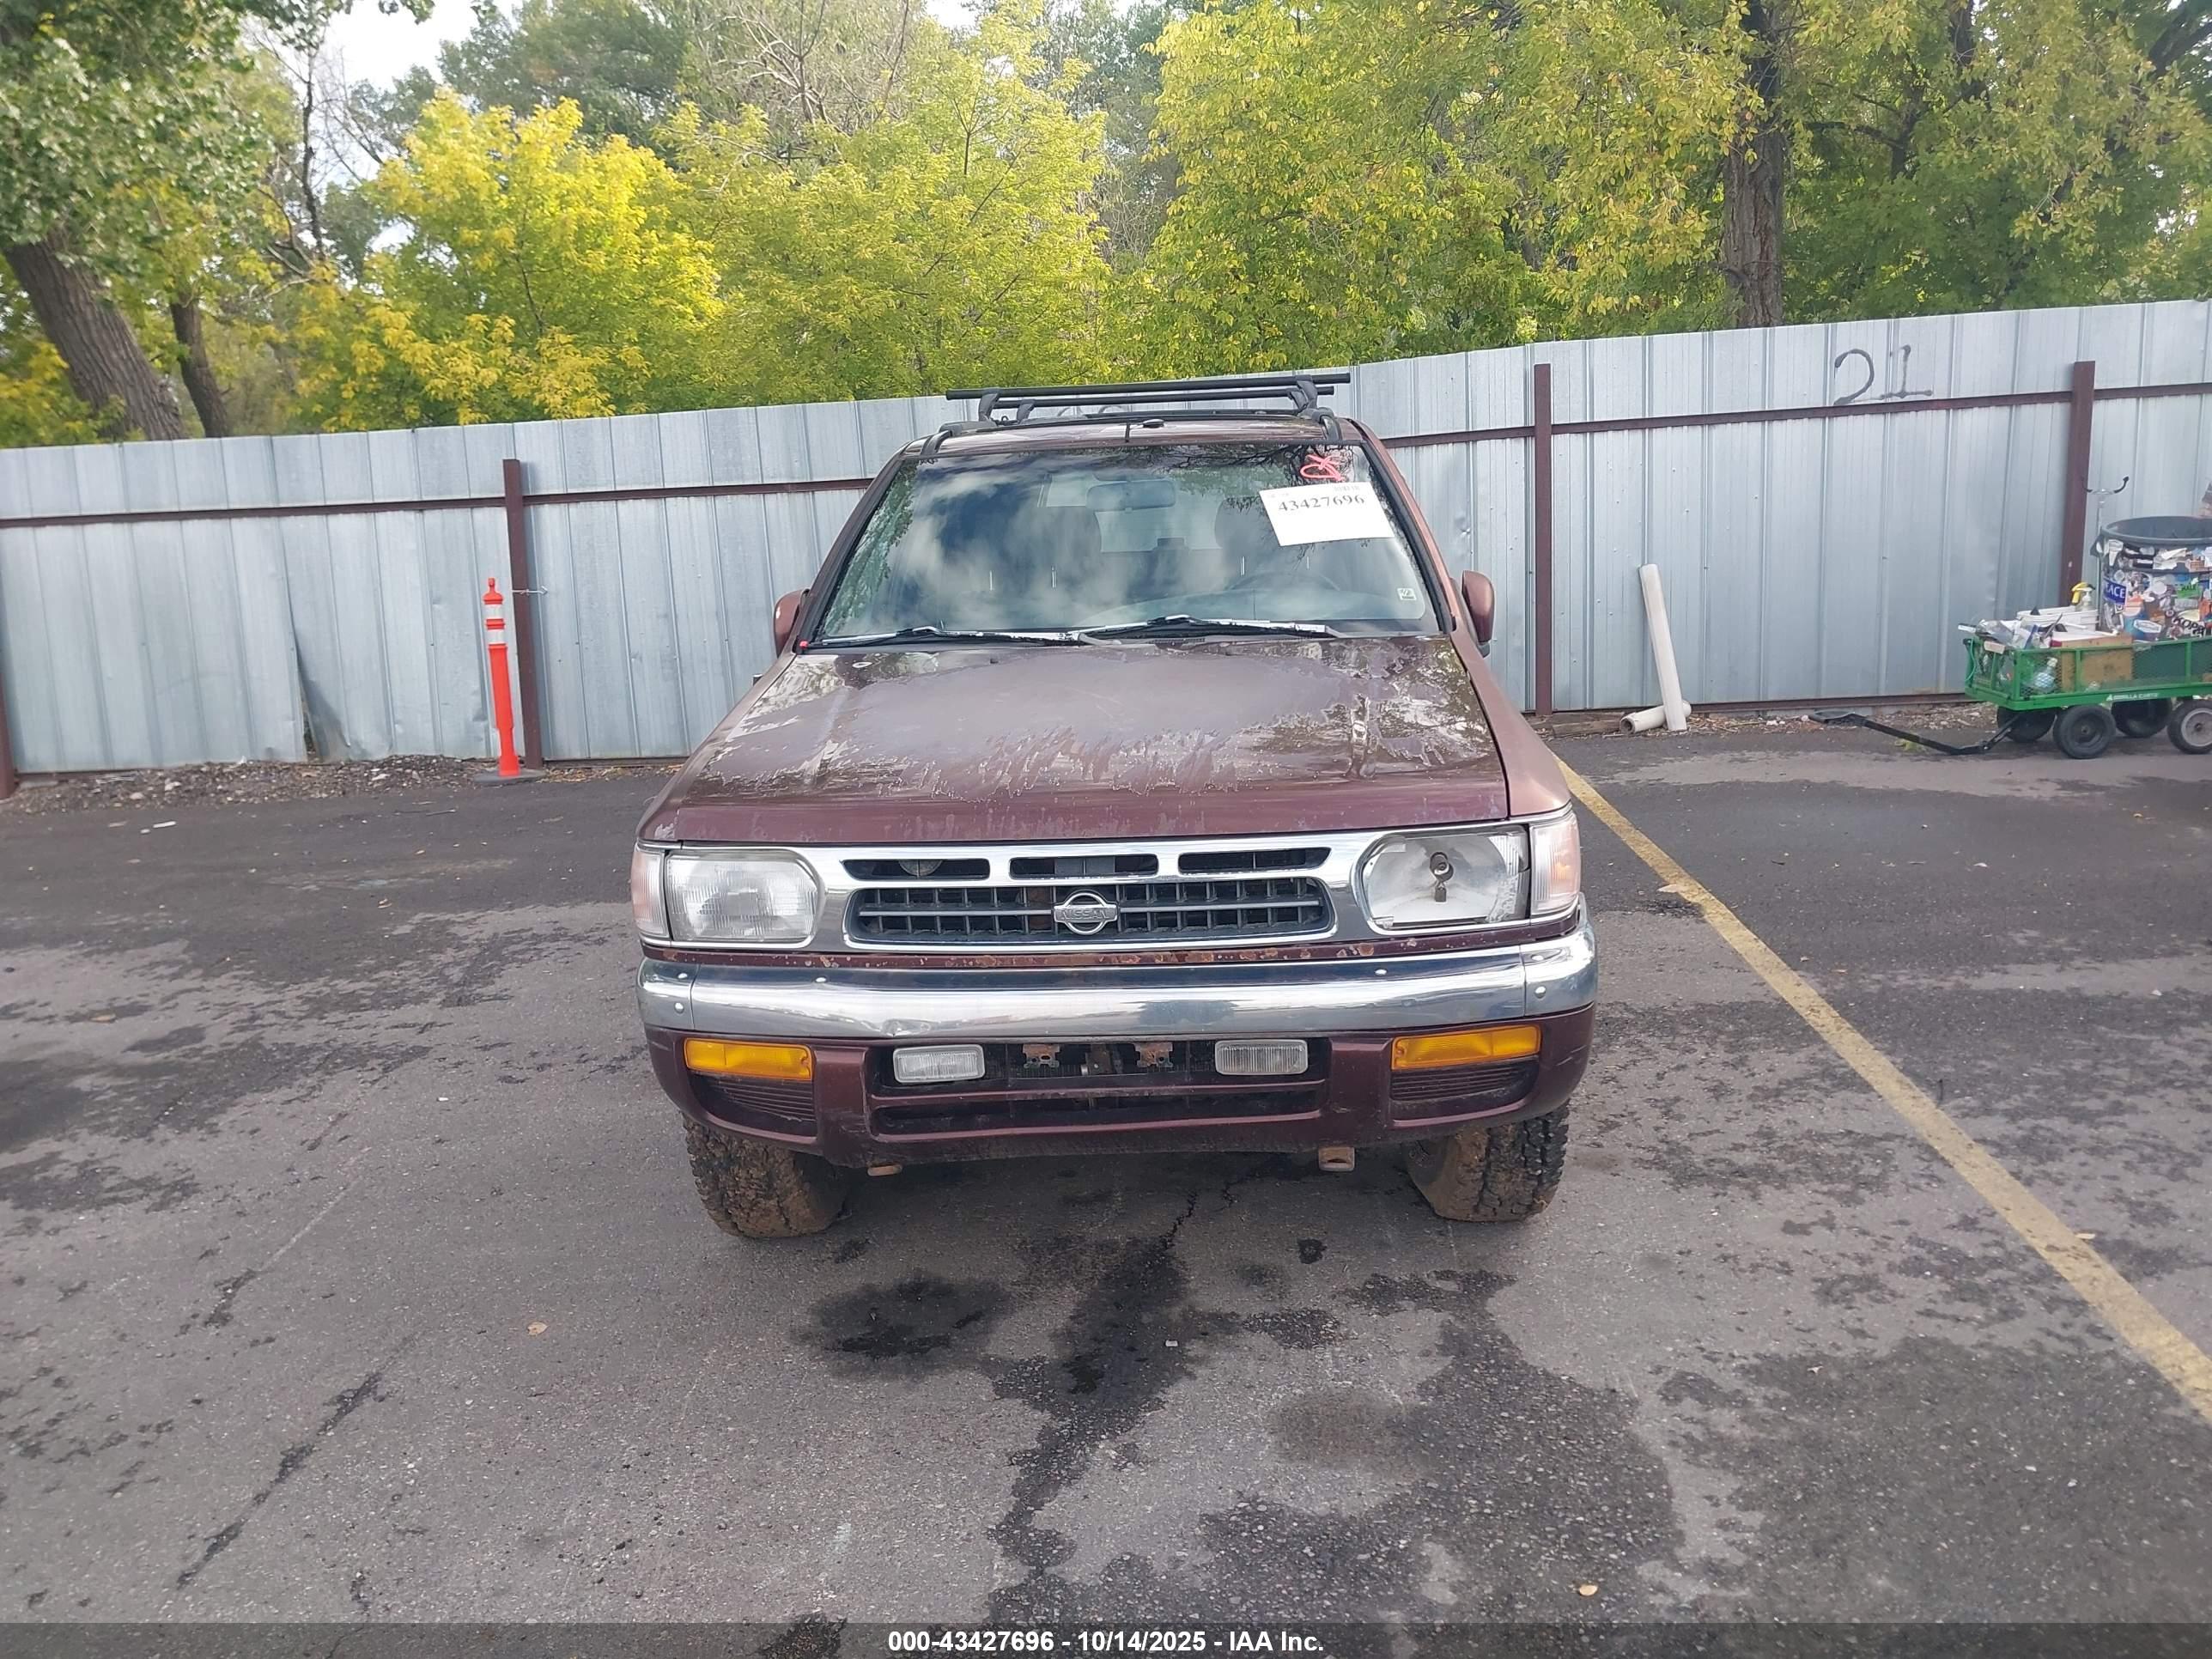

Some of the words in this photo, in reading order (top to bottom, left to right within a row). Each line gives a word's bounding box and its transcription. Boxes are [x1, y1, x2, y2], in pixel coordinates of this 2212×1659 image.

[1833, 344, 1934, 406] 21
[1278, 494, 1365, 513] 43427696
[1061, 908, 1109, 920] NISSAN
